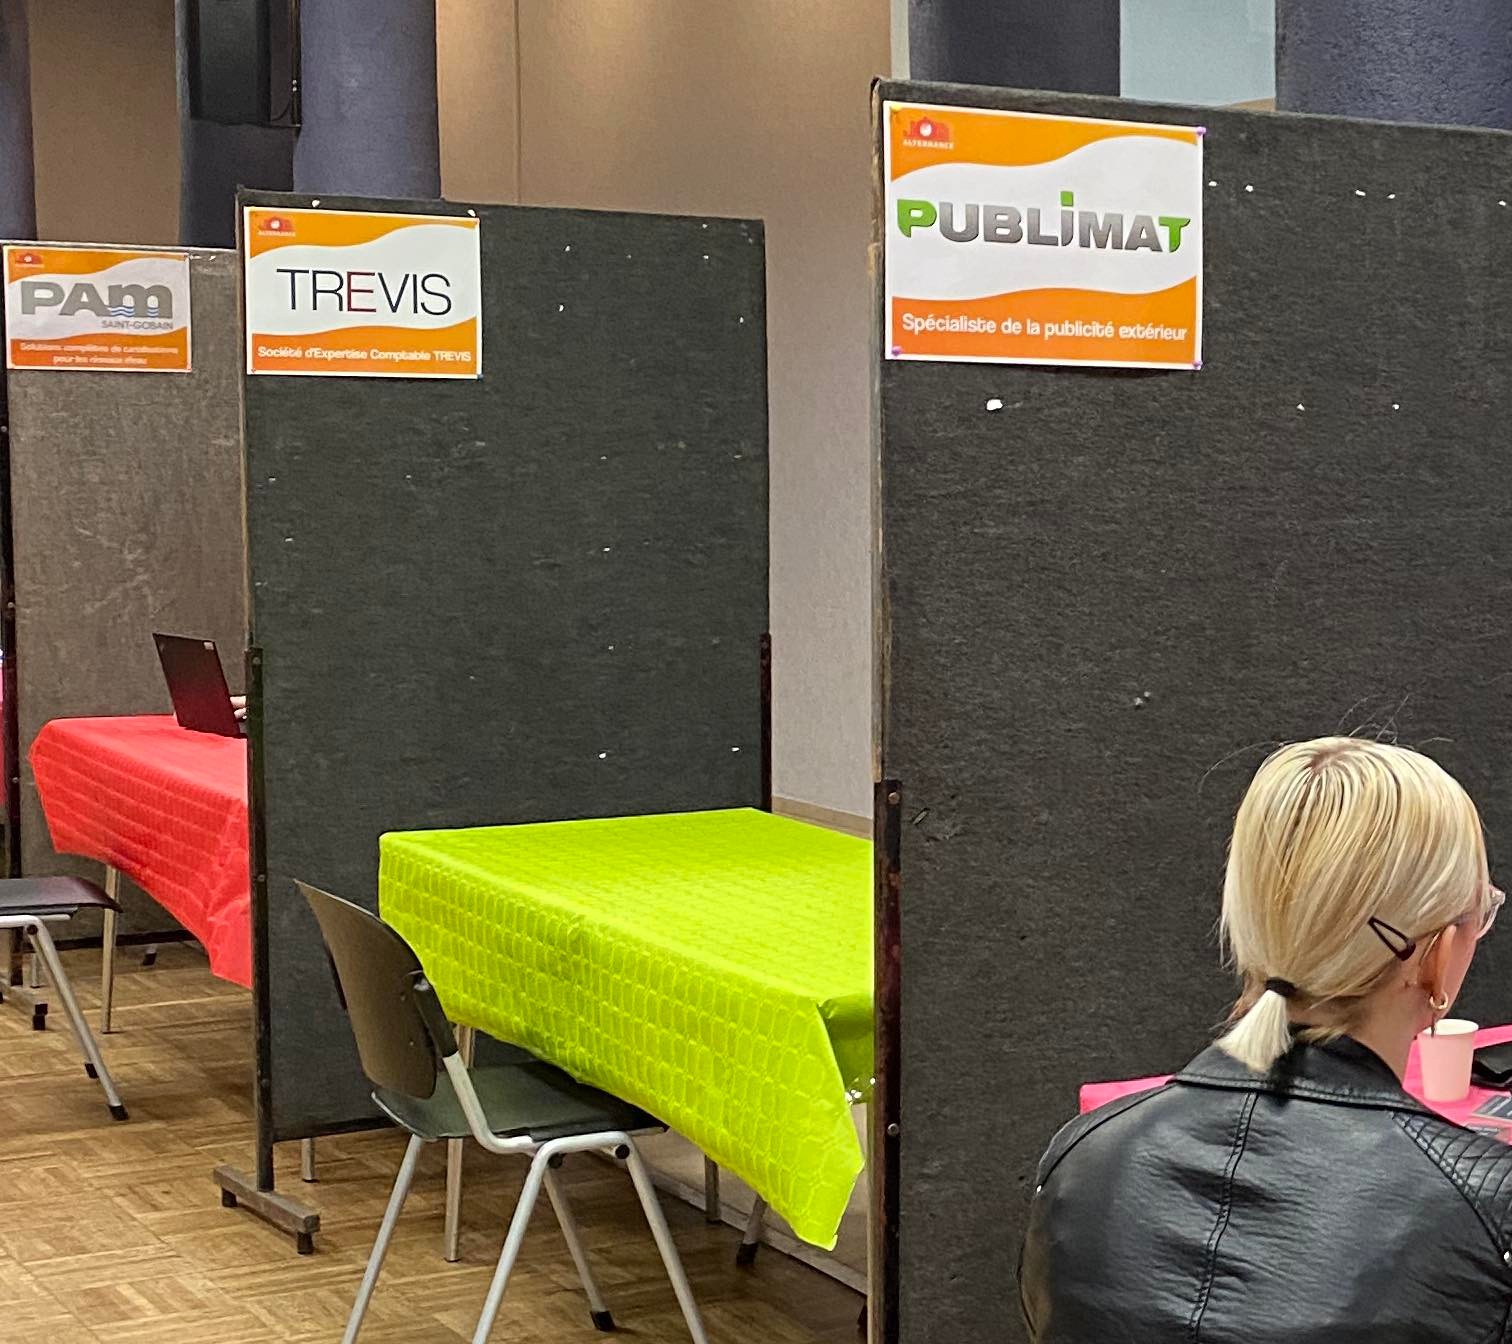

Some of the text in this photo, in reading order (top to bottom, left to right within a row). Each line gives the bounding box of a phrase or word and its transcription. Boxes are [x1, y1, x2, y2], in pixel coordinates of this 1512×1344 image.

[276, 268, 452, 316] TREVIS
[101, 320, 174, 330] SAINT-GOBAIN
[902, 313, 1187, 341] Spécialiste de la publicité extérieur
[433, 352, 472, 362] TREVIS
